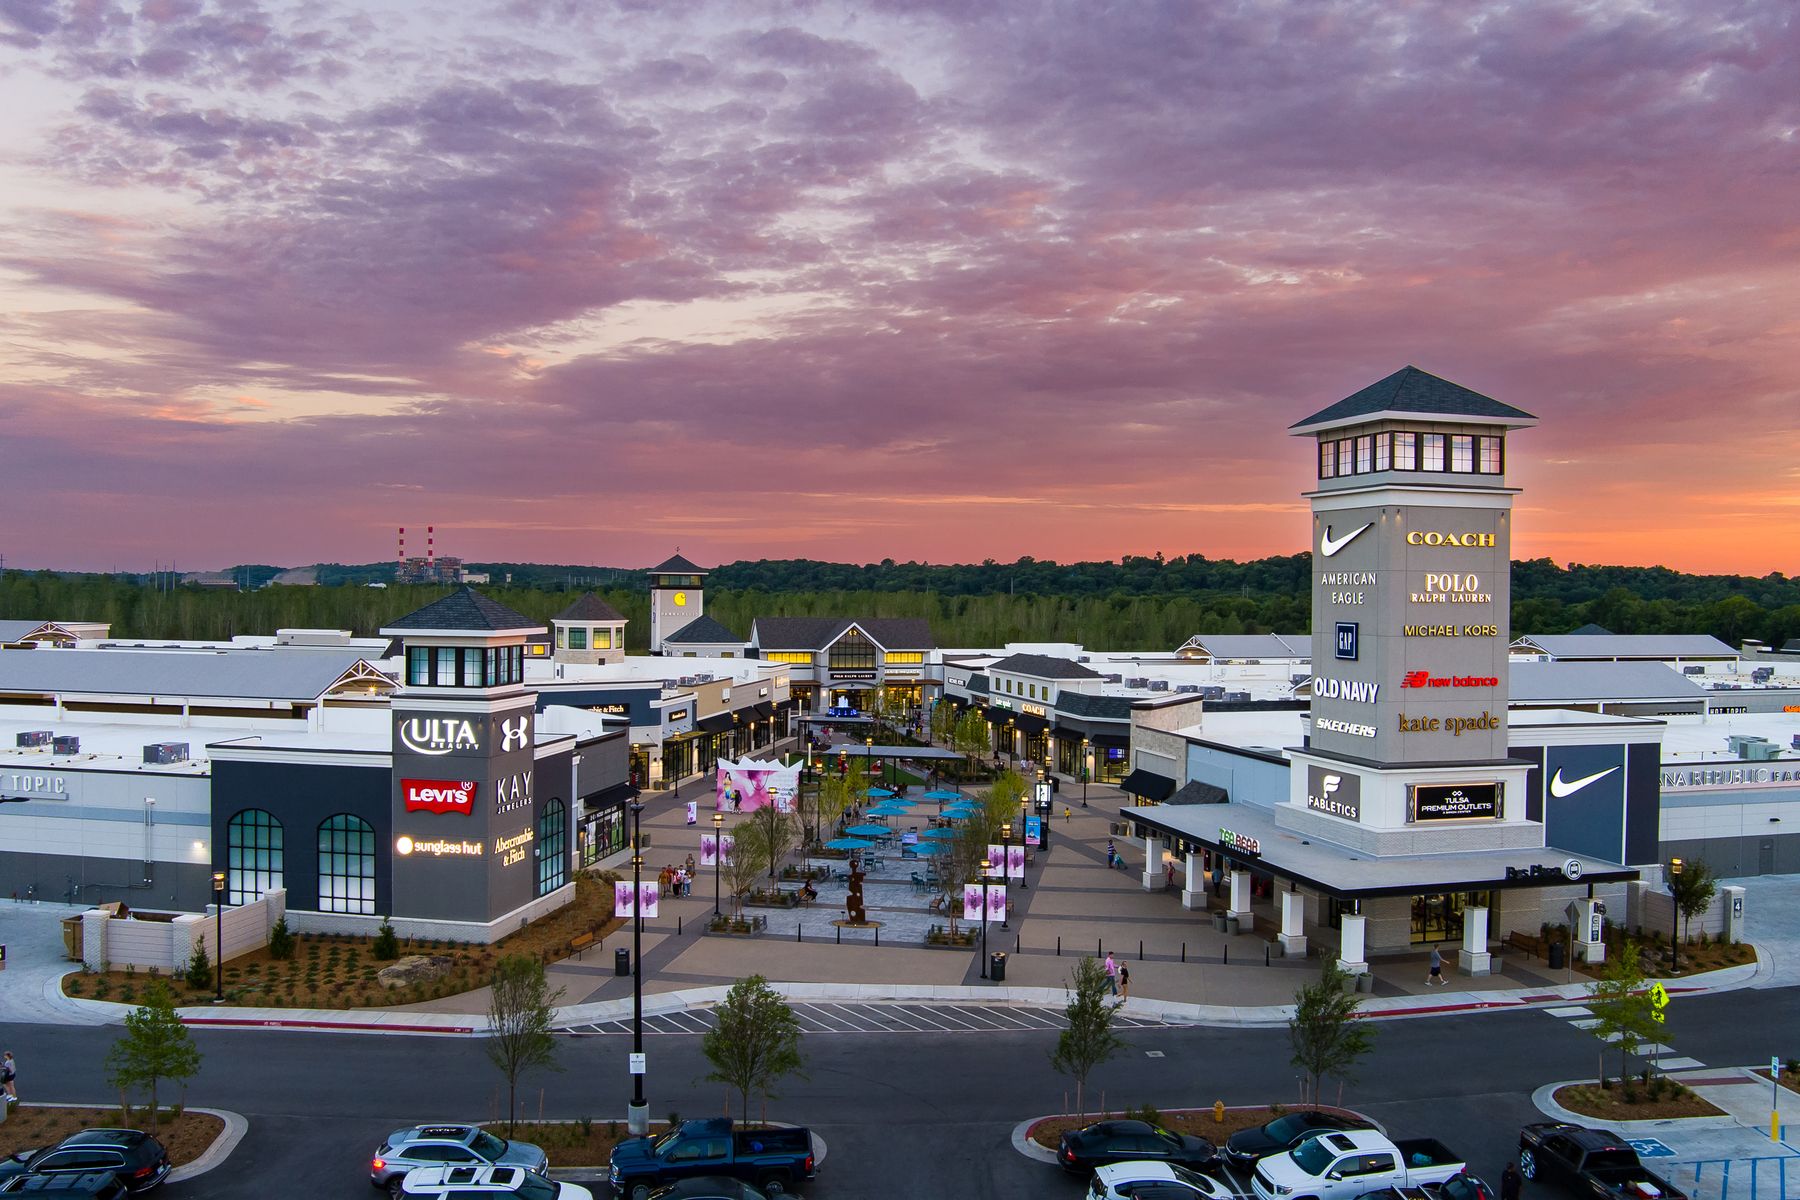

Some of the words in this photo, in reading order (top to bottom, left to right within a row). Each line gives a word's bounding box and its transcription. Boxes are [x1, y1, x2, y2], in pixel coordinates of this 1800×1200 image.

[1406, 531, 1496, 547] COACH
[1321, 573, 1377, 586] AMERICAN
[1424, 573, 1479, 592] POLO
[1332, 592, 1365, 605] EAGLE
[1410, 593, 1446, 603] RALPH
[1451, 593, 1492, 603] LAUREN
[1404, 625, 1460, 637] MICHAEL
[1463, 625, 1498, 637] KORS
[1339, 631, 1353, 650] GAP
[1314, 677, 1340, 699] OLD
[1341, 680, 1380, 704] NAVY
[1428, 677, 1452, 687] new
[1453, 676, 1499, 687] balance
[609, 704, 624, 713] Fitch
[1022, 703, 1045, 716] COACH
[411, 718, 477, 744] ULTA
[1316, 718, 1377, 738] SKECHERS
[1398, 712, 1440, 732] kate
[1445, 711, 1500, 737] spade
[430, 741, 480, 750] BEAUTY
[12, 775, 64, 794] TOPIC
[1692, 767, 1769, 786] REPUBLIC
[496, 771, 532, 804] KAY
[497, 797, 532, 815] JEWELERS
[1308, 795, 1358, 819] FABLETICS
[1421, 804, 1457, 812] PREMIUM
[1457, 803, 1492, 811] OUTLETS
[414, 840, 462, 856] sunglass
[462, 840, 483, 855] hut
[494, 828, 534, 855] Abercrombie
[1219, 827, 1236, 846] TEA
[1236, 834, 1260, 854] BEAR
[503, 855, 510, 867] &
[509, 846, 526, 865] Fitch
[1735, 903, 1741, 911] 4
